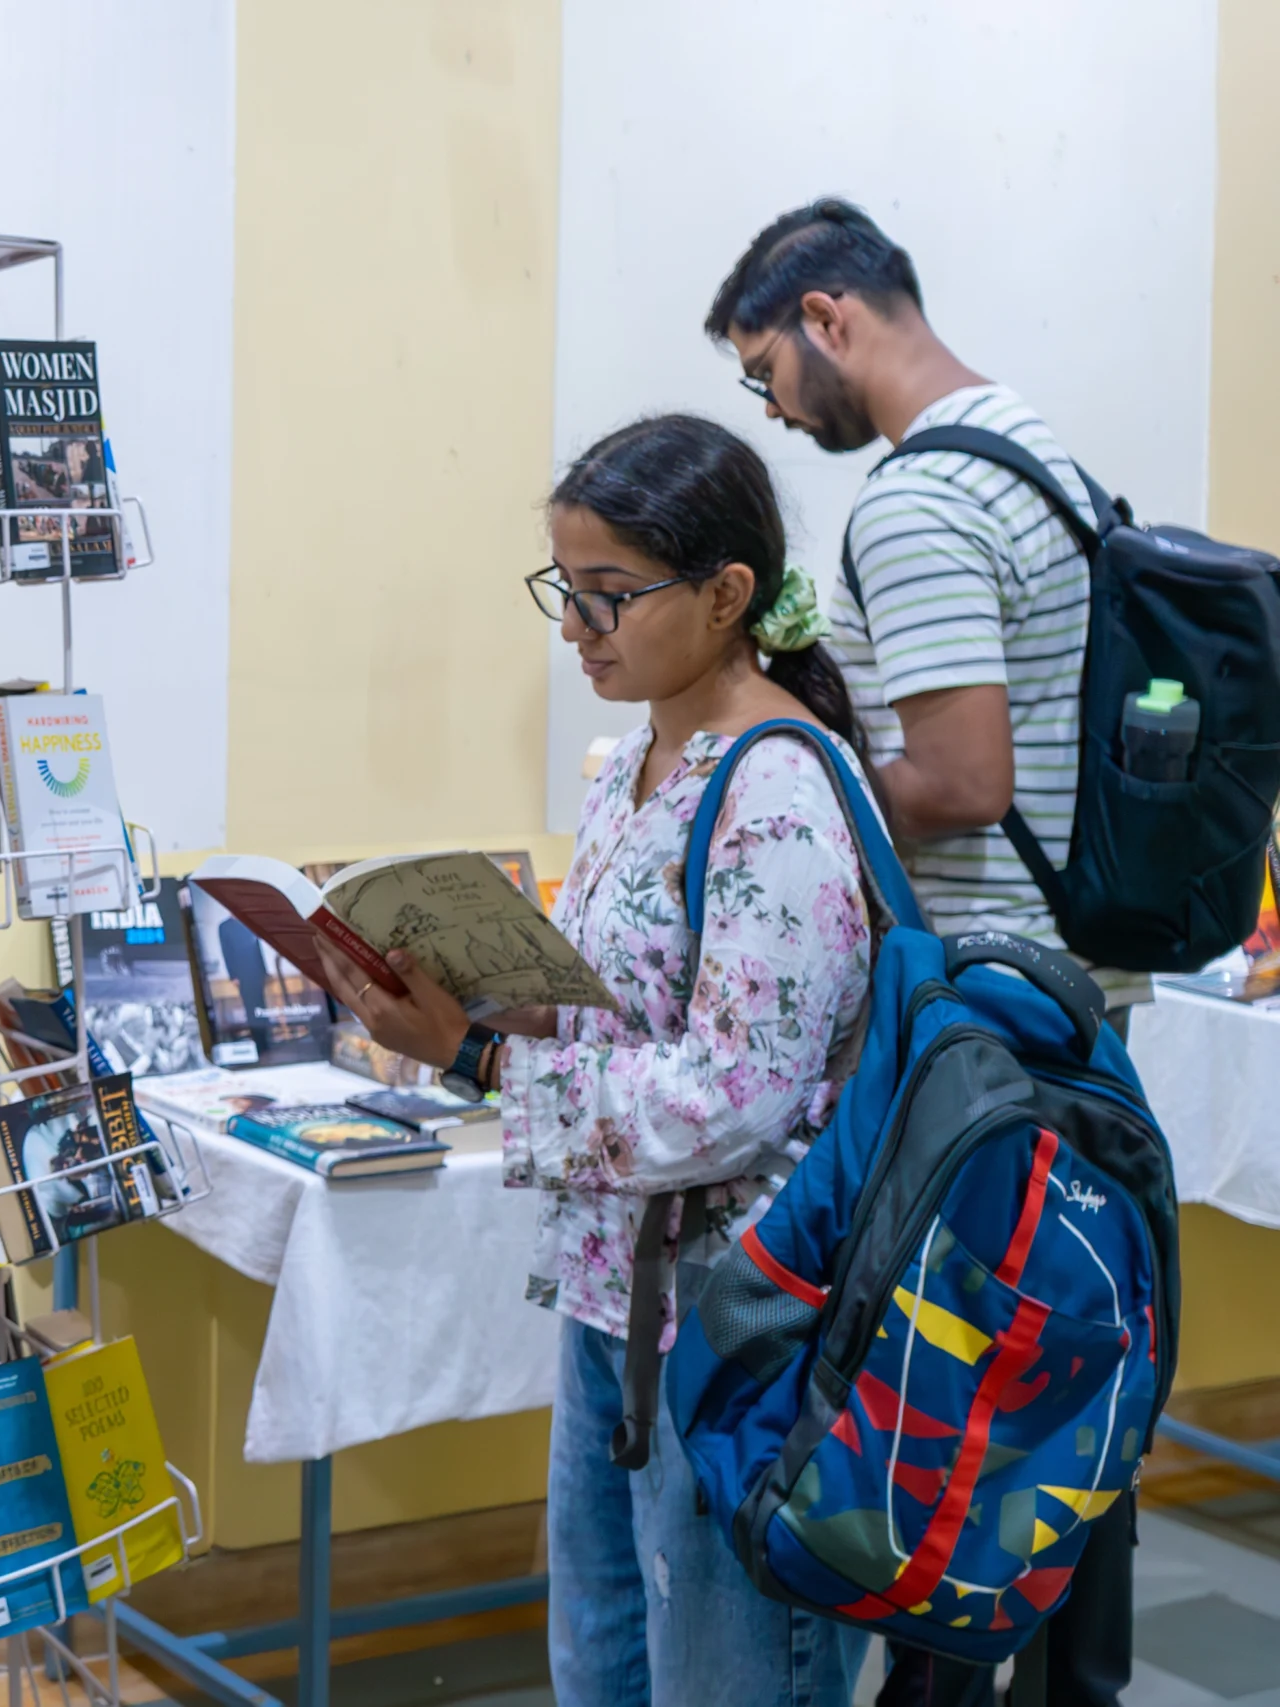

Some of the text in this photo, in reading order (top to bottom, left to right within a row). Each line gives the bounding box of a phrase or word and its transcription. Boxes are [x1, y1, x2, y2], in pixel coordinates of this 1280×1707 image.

[1, 351, 94, 380] WOMEN
[4, 388, 99, 422] MASJID
[27, 715, 89, 726] HARDWIRING
[20, 733, 103, 753] HAPPINESS
[82, 1376, 104, 1397] 100
[65, 1384, 130, 1428] SELECTED
[79, 1409, 126, 1442] POEMS
